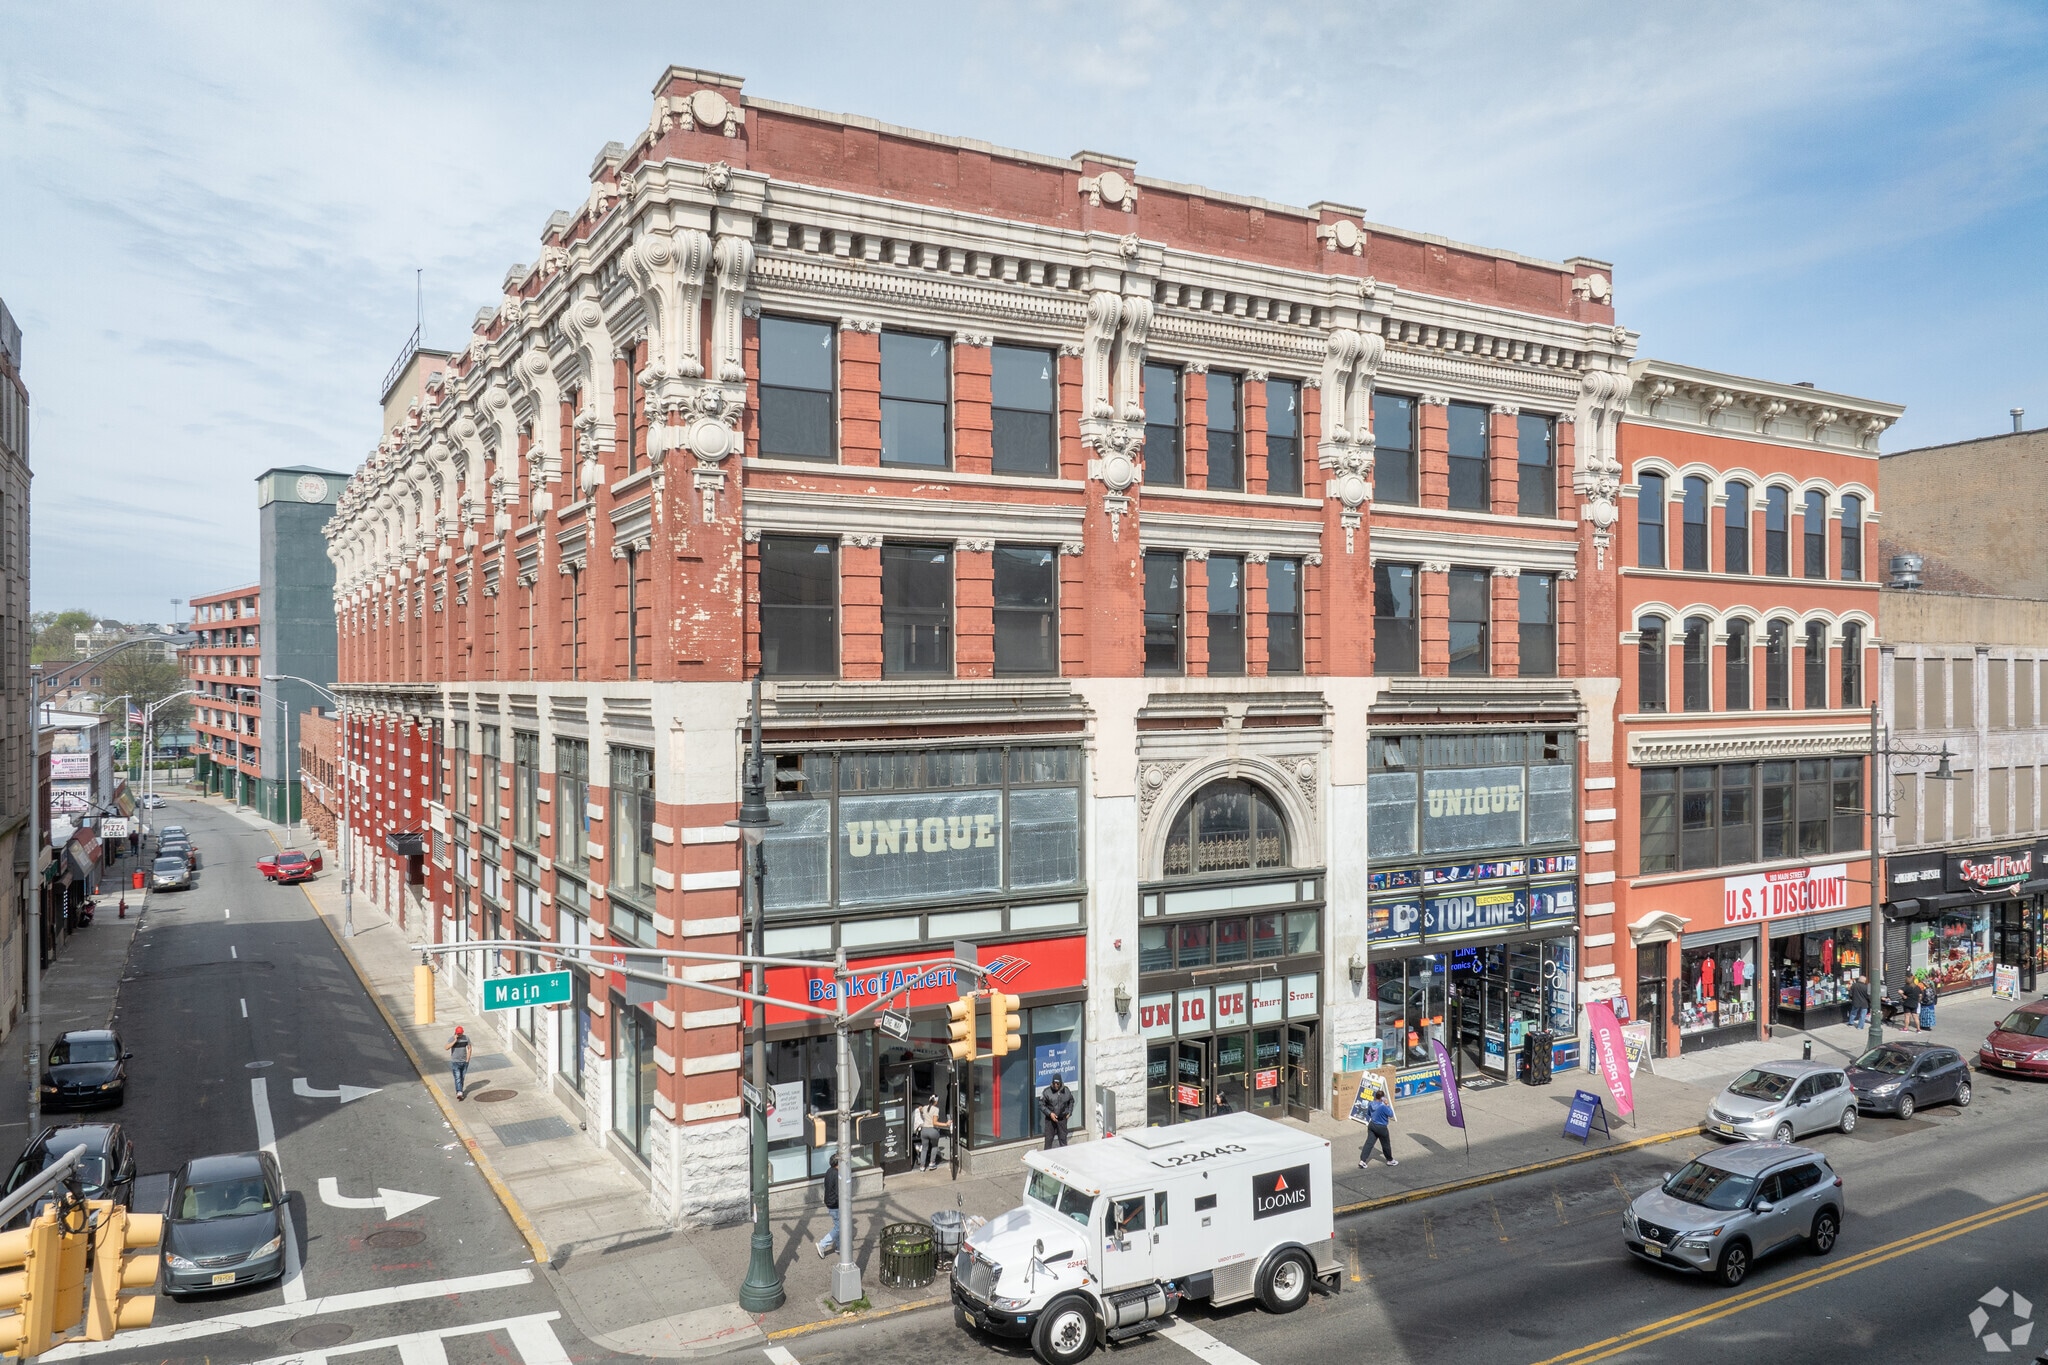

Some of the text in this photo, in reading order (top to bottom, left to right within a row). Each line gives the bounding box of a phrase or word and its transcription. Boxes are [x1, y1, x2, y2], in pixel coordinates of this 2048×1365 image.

[304, 482, 320, 490] PPA
[1427, 784, 1520, 818] UNIQUE
[847, 814, 995, 858] UNIQUE
[1789, 870, 1806, 880] STREET
[1959, 856, 2001, 886] Sagal
[2001, 851, 2032, 876] Food
[1477, 893, 1514, 906] ELECTRONICS
[1726, 875, 1846, 921] U.S. 1 DISCOUNT
[866, 971, 889, 995] of
[495, 979, 559, 1002] Main St
[1038, 1065, 1076, 1076] retirement plan
[1042, 1060, 1071, 1069] Design your
[1570, 1118, 1587, 1129] HERE
[1572, 1112, 1588, 1122] SOLD
[1151, 1143, 1247, 1169] L22443
[1050, 1162, 1071, 1175] Loomis
[1257, 1188, 1306, 1212] LOOMIS
[1067, 1259, 1088, 1269] 22443
